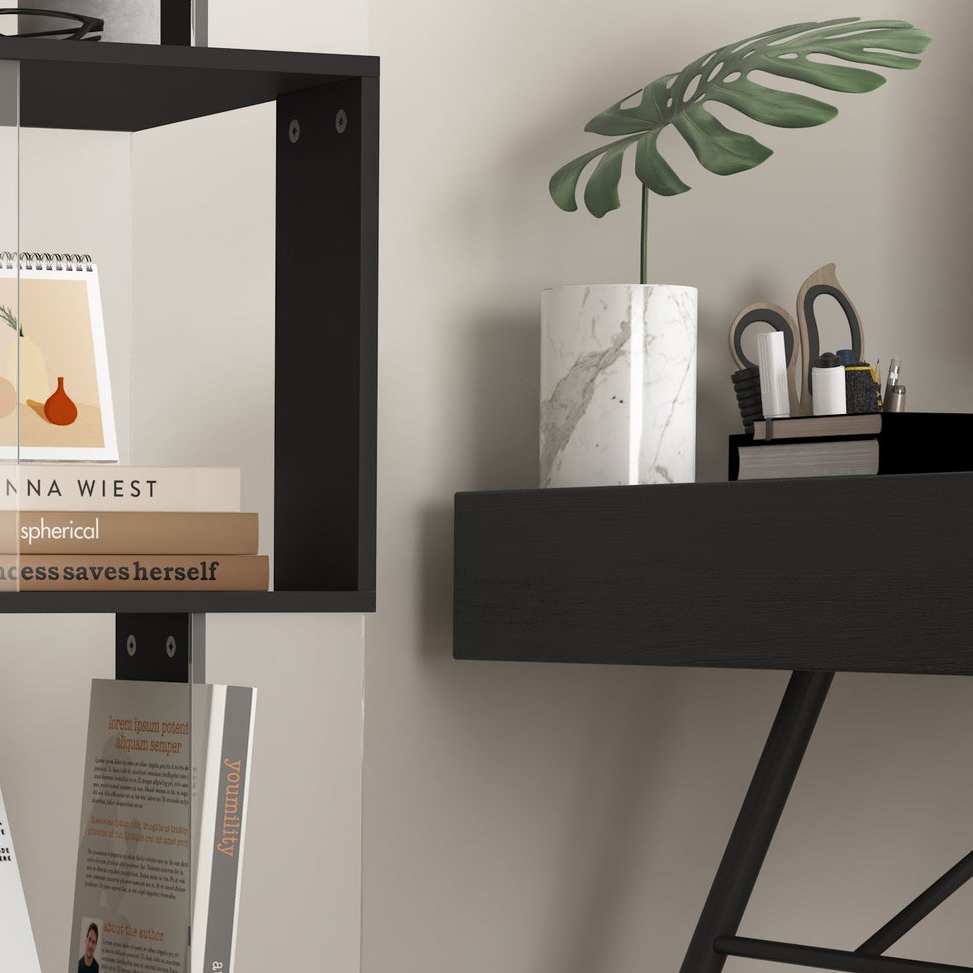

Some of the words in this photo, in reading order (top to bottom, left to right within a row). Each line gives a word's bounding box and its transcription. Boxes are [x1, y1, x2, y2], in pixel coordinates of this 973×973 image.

[77, 479, 157, 498] WIEST
[20, 517, 99, 545] spherical
[63, 564, 130, 581] saves
[133, 560, 220, 581] herself
[108, 715, 133, 731] lorem
[134, 718, 160, 734] ipsum
[161, 720, 189, 737] potent
[115, 735, 148, 752] aliquam
[149, 740, 182, 756] semper
[217, 758, 241, 857] youmility
[102, 921, 124, 935] about
[125, 923, 137, 937] the
[139, 928, 164, 942] author
